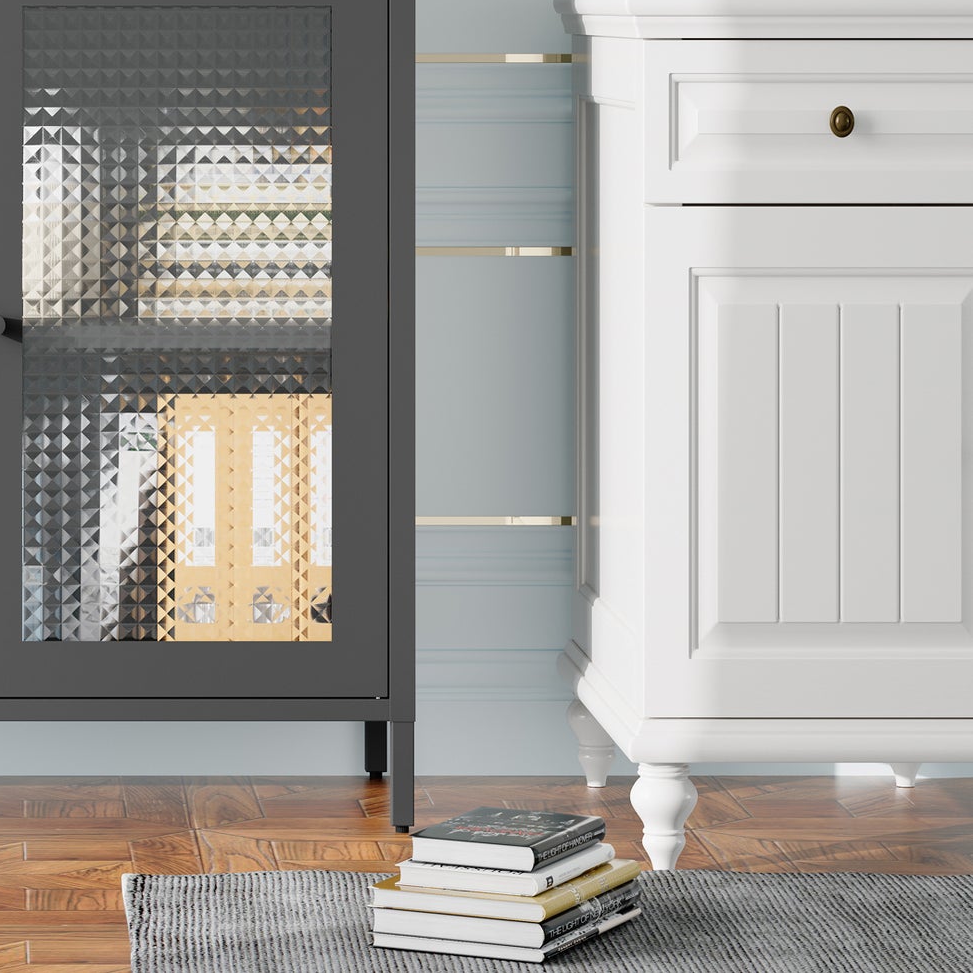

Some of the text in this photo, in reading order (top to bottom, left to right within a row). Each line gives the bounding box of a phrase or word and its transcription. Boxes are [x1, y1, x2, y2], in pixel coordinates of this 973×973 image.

[537, 850, 548, 860] THE
[547, 844, 562, 858] LIGHT
[561, 841, 570, 851] OF
[549, 927, 562, 938] THE
[561, 918, 581, 931] LIGHT
[580, 911, 590, 924] OF
